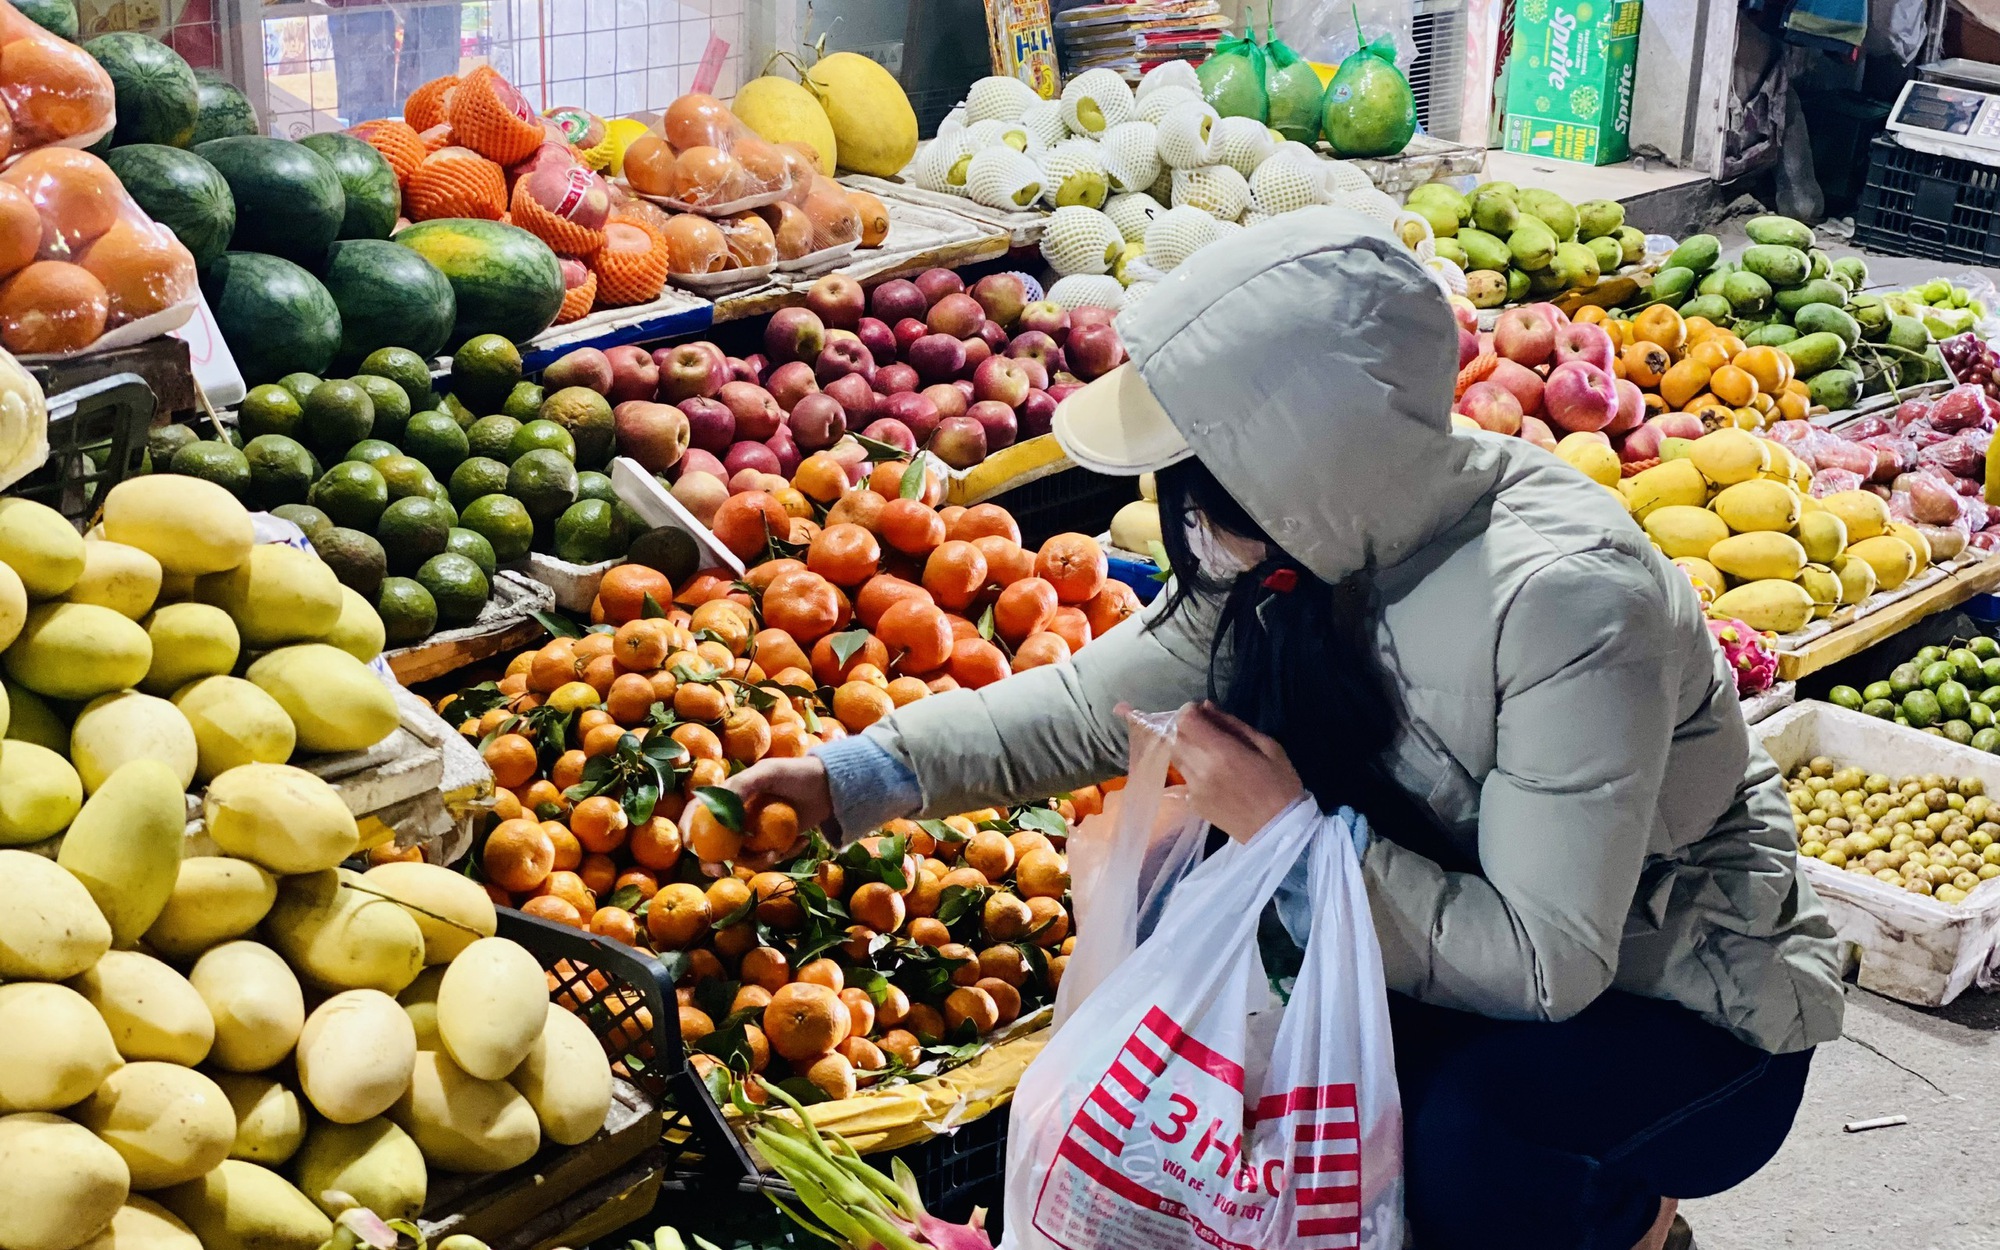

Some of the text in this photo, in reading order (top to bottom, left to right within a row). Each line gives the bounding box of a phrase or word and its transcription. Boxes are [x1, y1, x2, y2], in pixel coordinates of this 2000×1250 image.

[1548, 6, 1577, 91] Sprite
[1614, 63, 1633, 135] Sprite
[1150, 1092, 1198, 1145] 3
